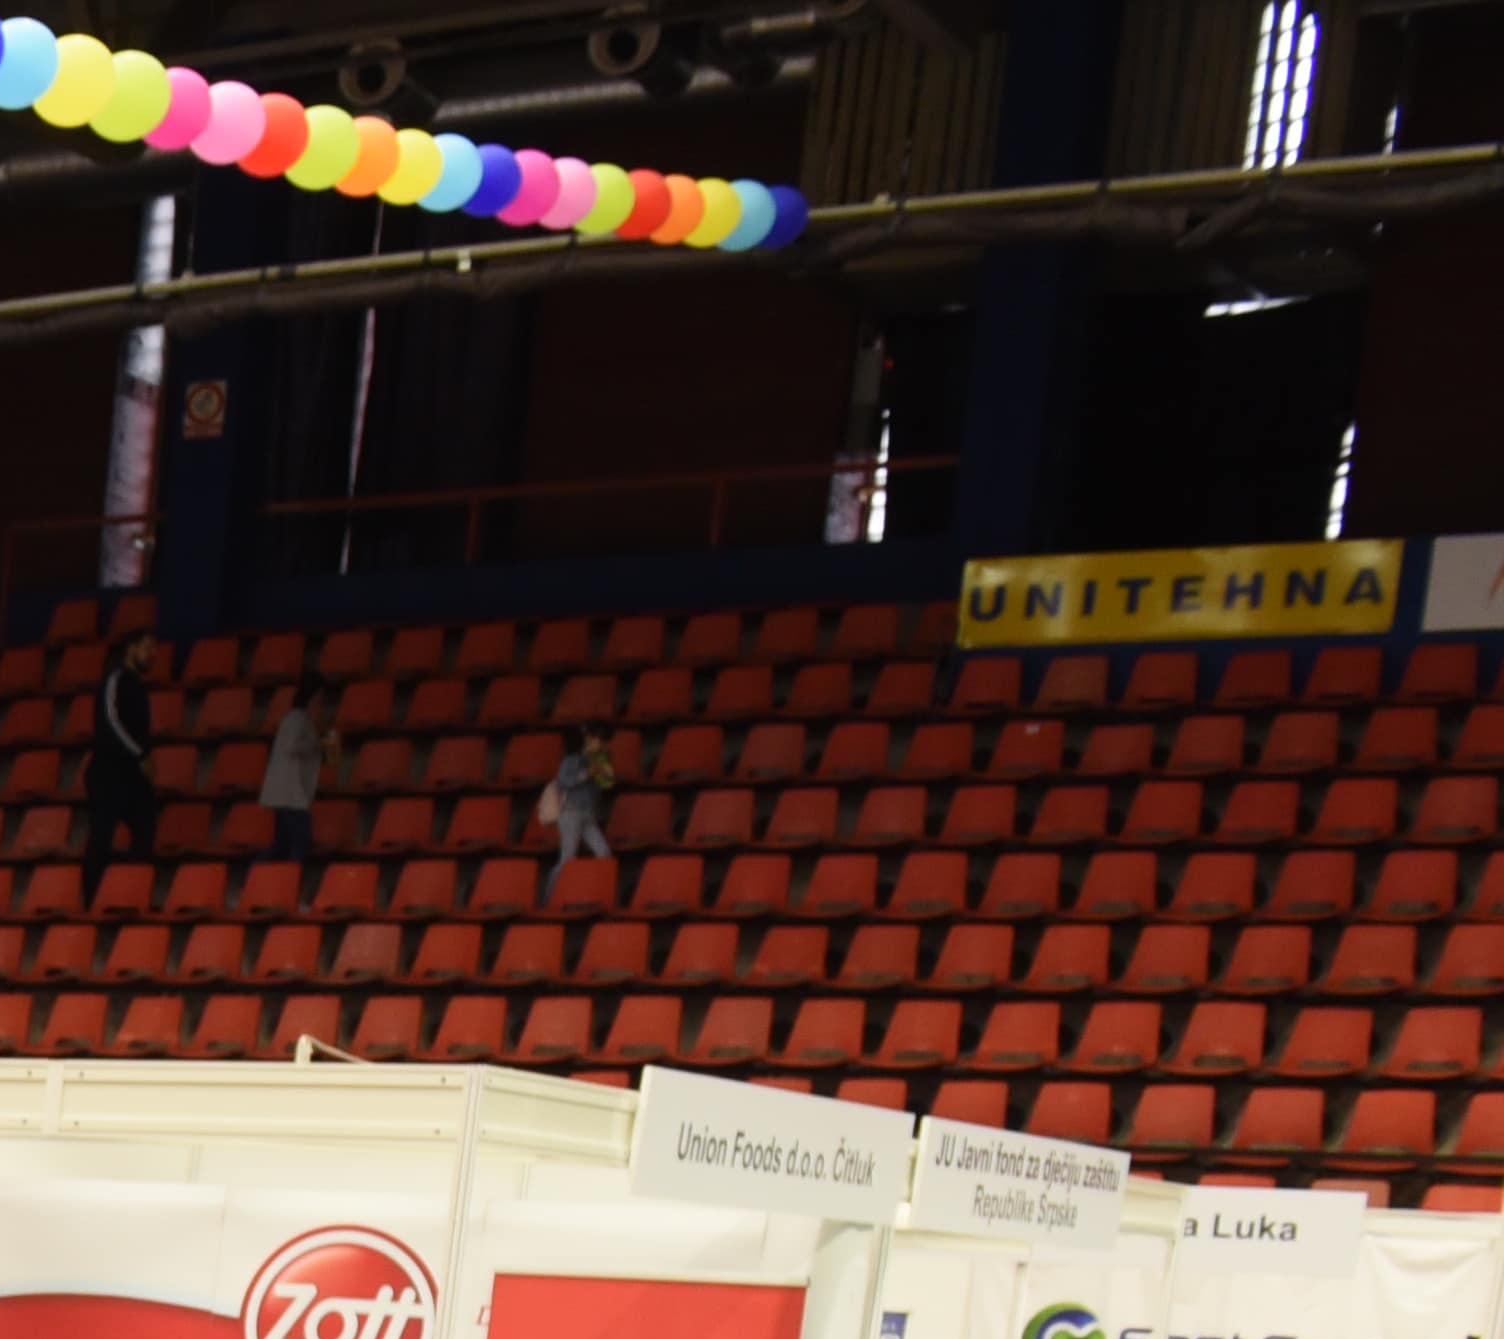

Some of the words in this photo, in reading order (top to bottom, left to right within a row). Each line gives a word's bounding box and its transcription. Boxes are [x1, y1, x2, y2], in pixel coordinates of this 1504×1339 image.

[967, 567, 1385, 622] UNITEHNA
[675, 1123, 728, 1167] Union
[732, 1130, 782, 1173] Foods
[831, 1135, 876, 1190] Čitluk
[935, 1140, 953, 1168] JU
[955, 1143, 993, 1176] Javni
[996, 1144, 1023, 1177] fond
[972, 1186, 1033, 1226] Republike
[1036, 1193, 1078, 1233] Srpske
[1212, 1212, 1298, 1243] Luka
